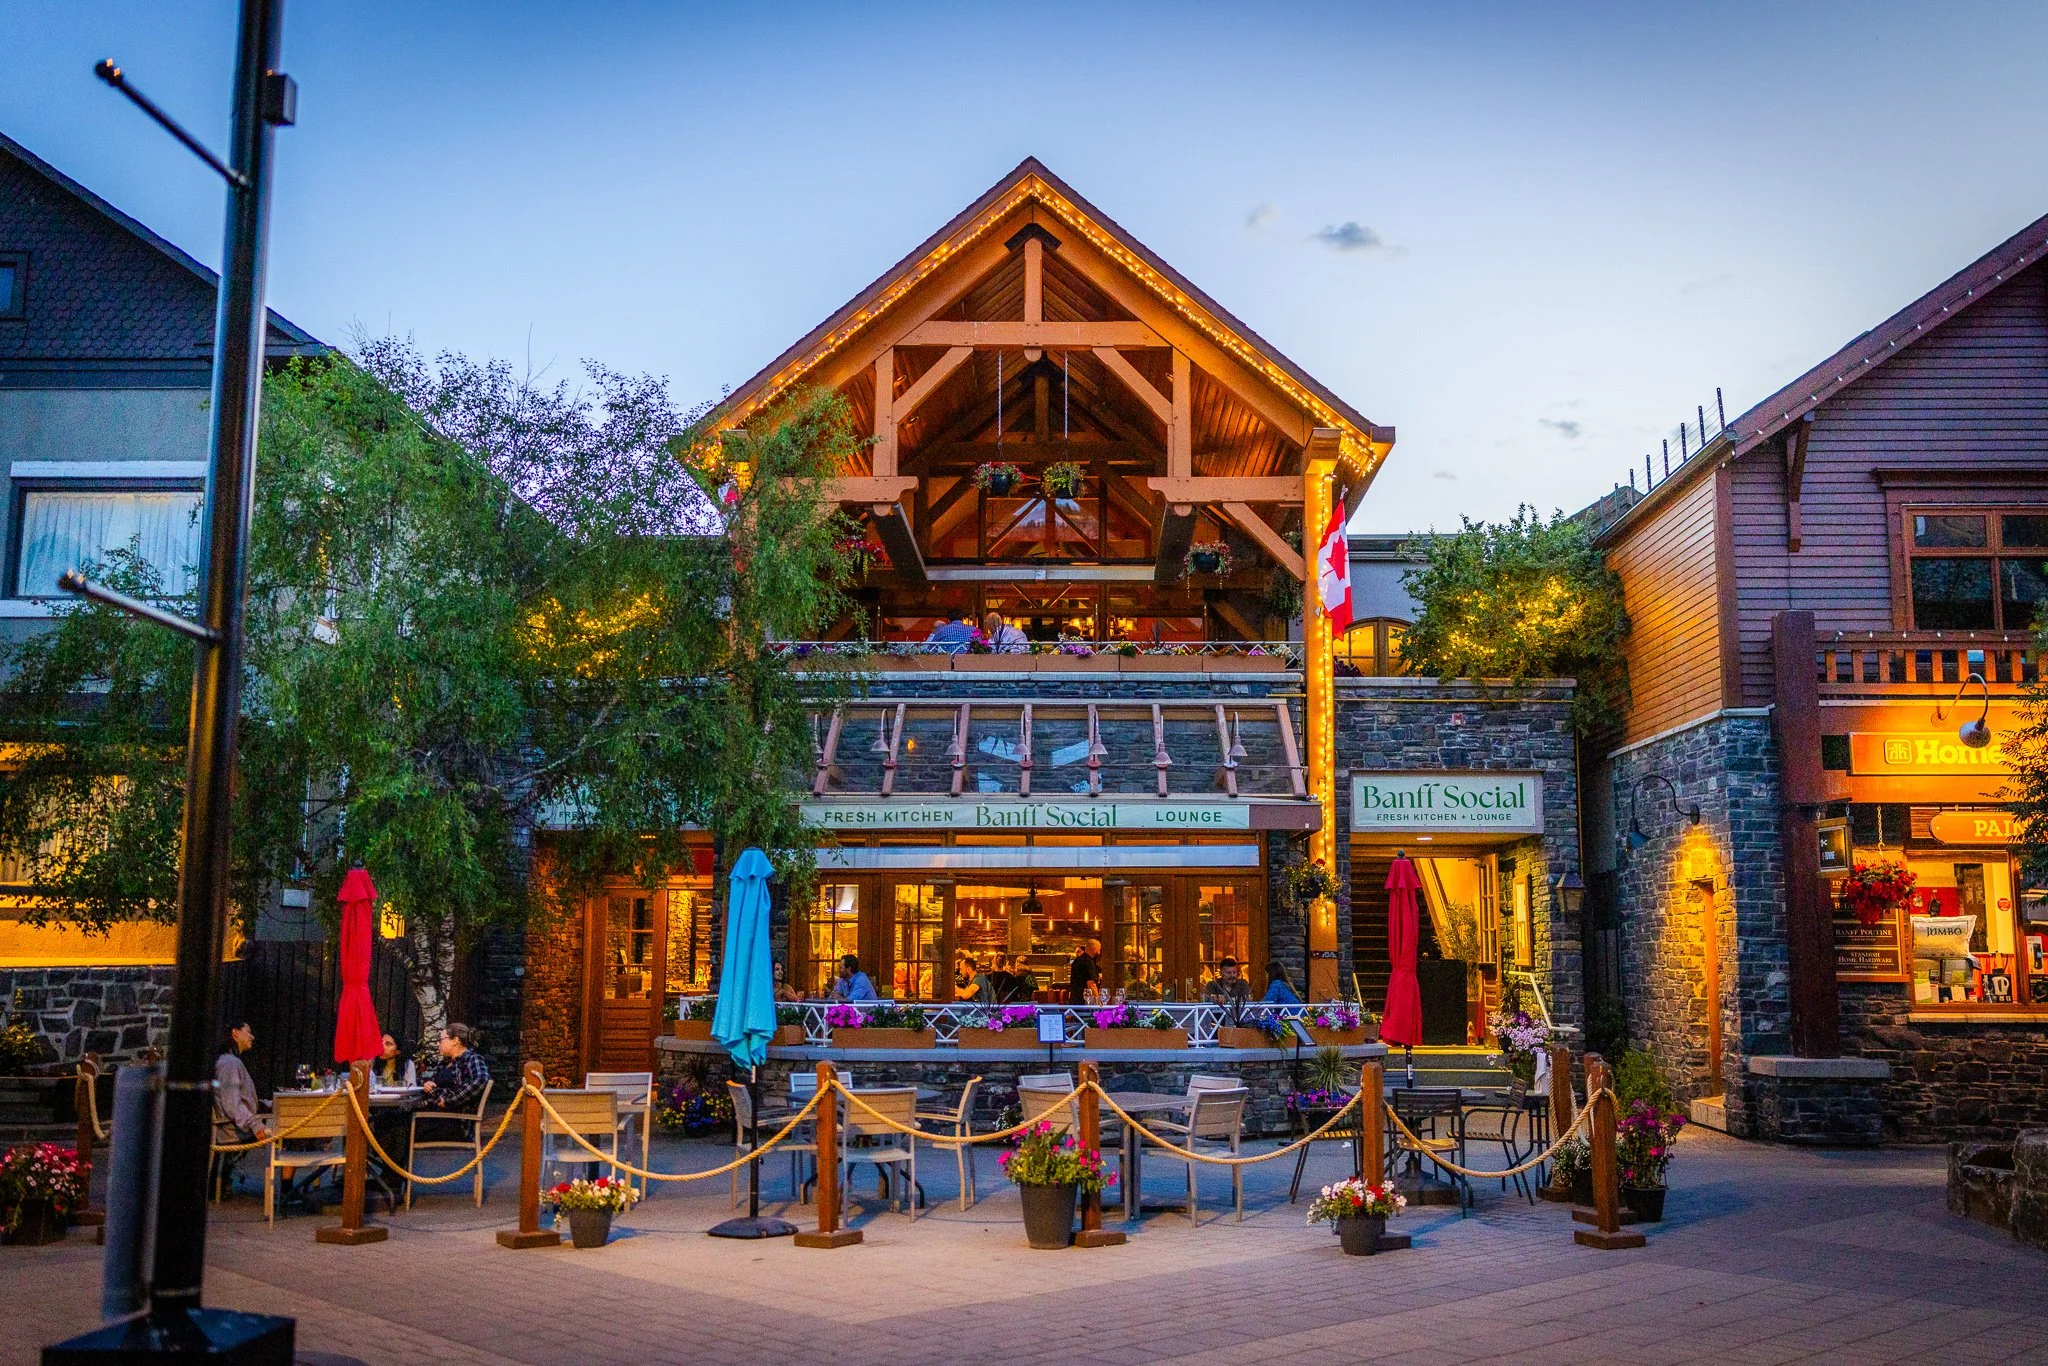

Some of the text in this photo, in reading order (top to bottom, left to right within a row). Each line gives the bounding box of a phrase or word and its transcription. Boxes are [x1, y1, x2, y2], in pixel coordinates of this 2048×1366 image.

[1914, 739, 2006, 765] Home
[1363, 782, 1525, 809] Banff Social
[824, 804, 1222, 827] FRESH KITCHEN Banff Social LOUNGE
[1377, 813, 1409, 821] FRESH
[1414, 813, 1457, 821] KITCHEN
[1470, 813, 1512, 821] LOUNGE
[1974, 819, 2029, 837] PAIN
[1927, 927, 1962, 938] JUMBO
